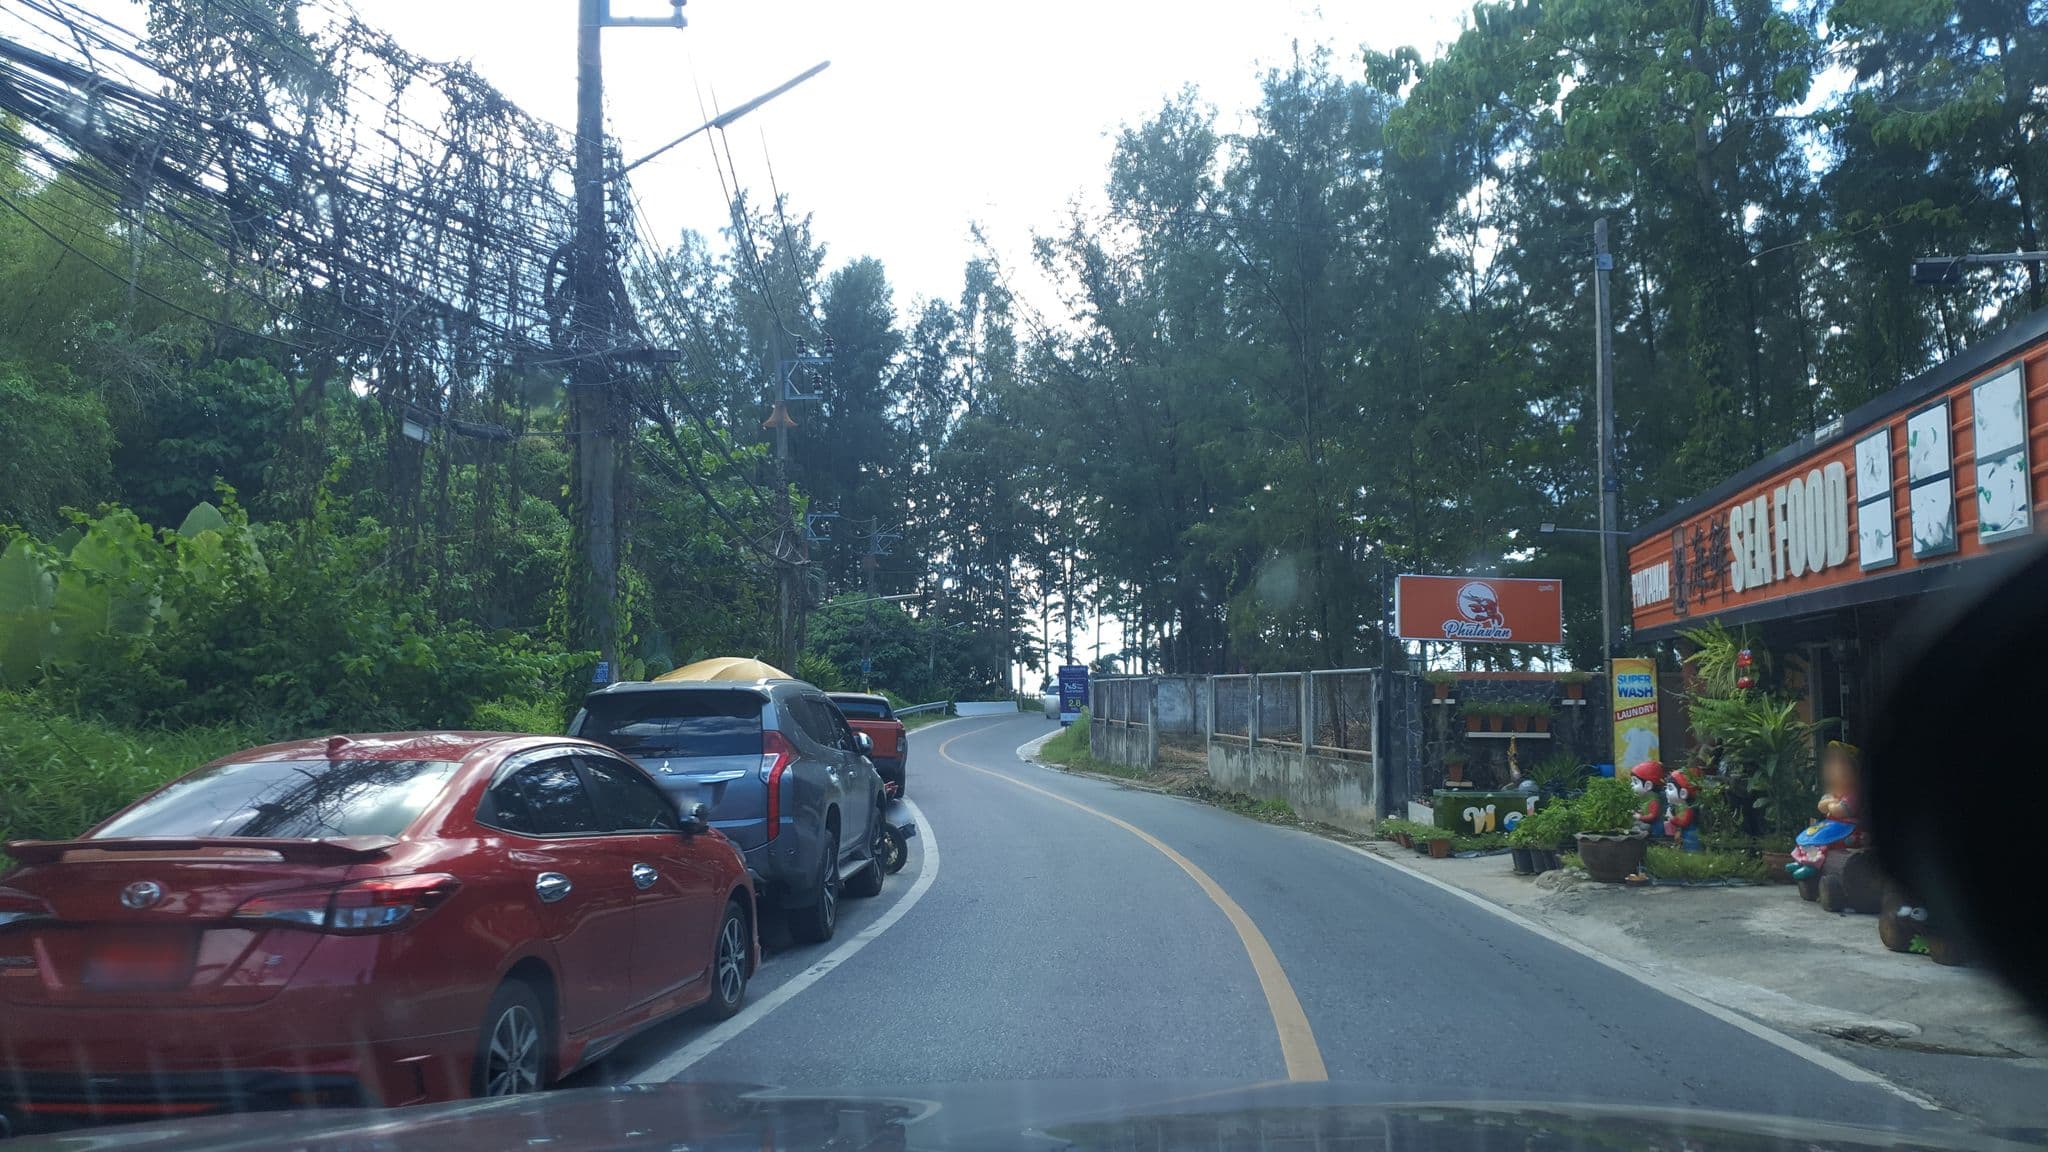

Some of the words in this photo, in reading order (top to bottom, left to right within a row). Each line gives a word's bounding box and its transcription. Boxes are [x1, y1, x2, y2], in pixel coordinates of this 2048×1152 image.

[1729, 494, 1772, 593] SEA
[1773, 461, 1848, 580] FOOD
[1443, 620, 1513, 639] Phutawan
[1617, 675, 1652, 686] SUPER
[1617, 687, 1653, 698] WASH
[1617, 704, 1655, 720] LAUNDRY
